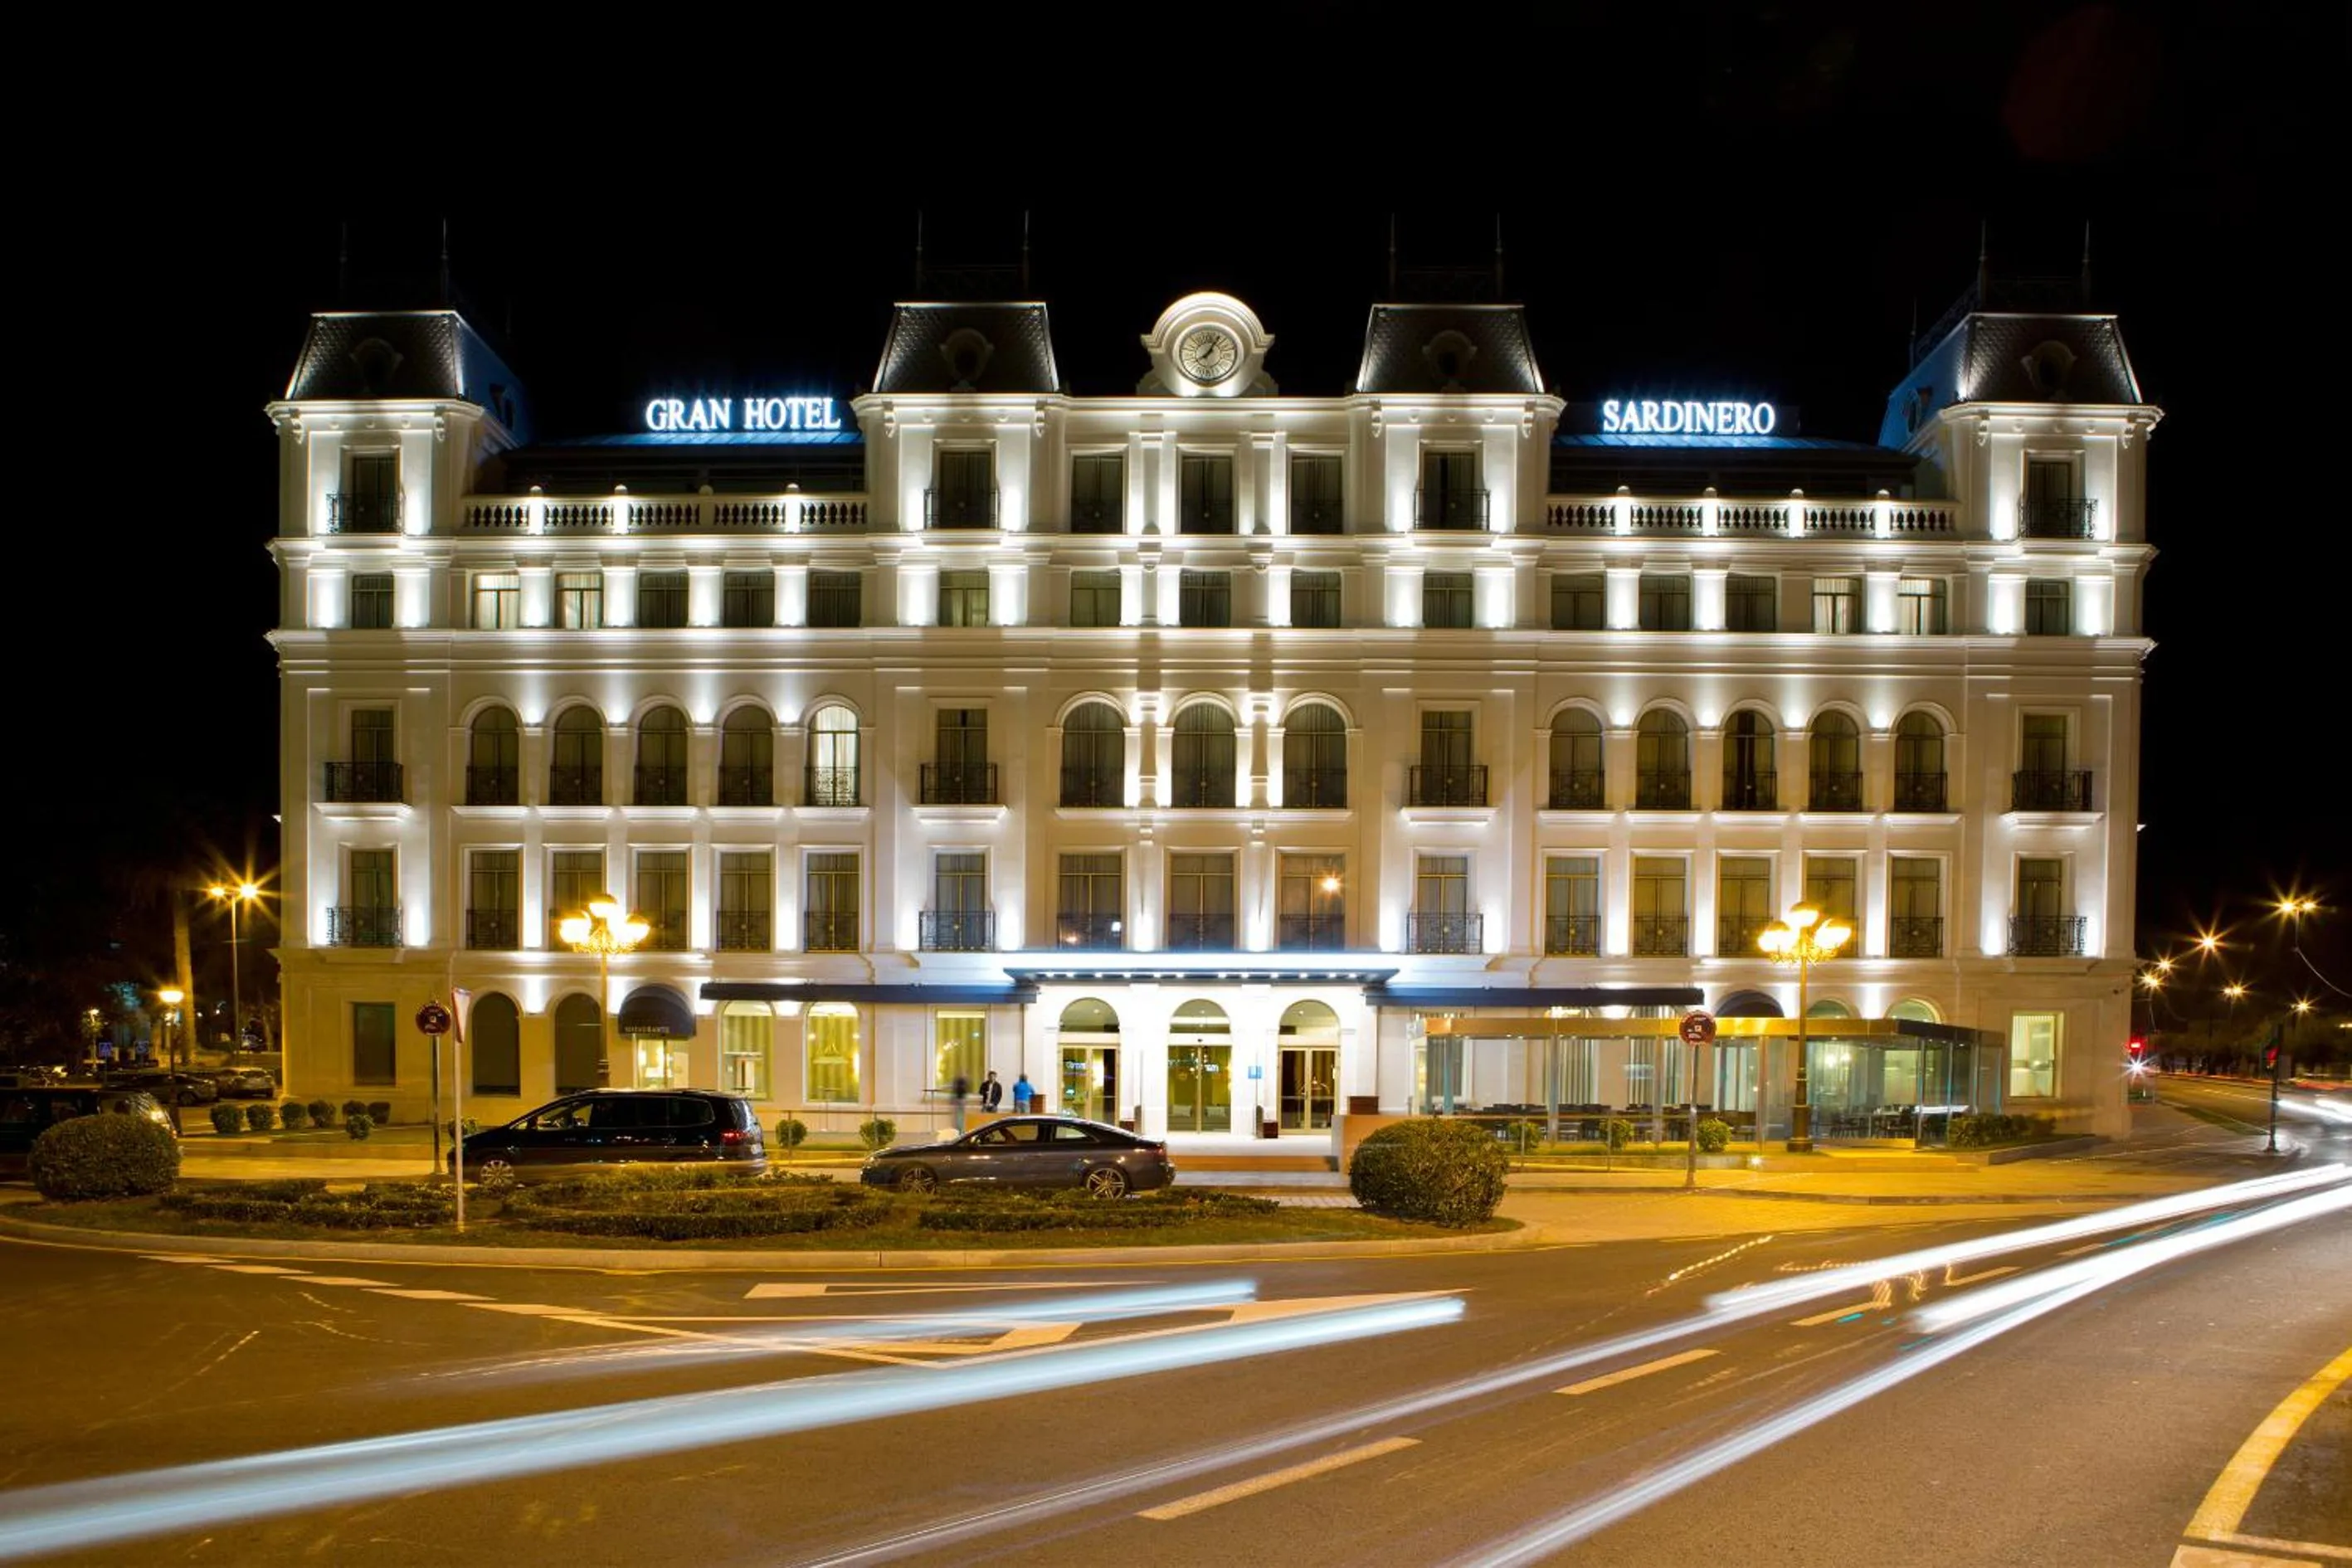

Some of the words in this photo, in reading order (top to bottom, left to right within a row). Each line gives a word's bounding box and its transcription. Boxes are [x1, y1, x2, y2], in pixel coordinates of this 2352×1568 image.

[645, 398, 731, 431] GRAN
[743, 397, 840, 430] HOTEL
[1603, 399, 1775, 434] SARDINERO
